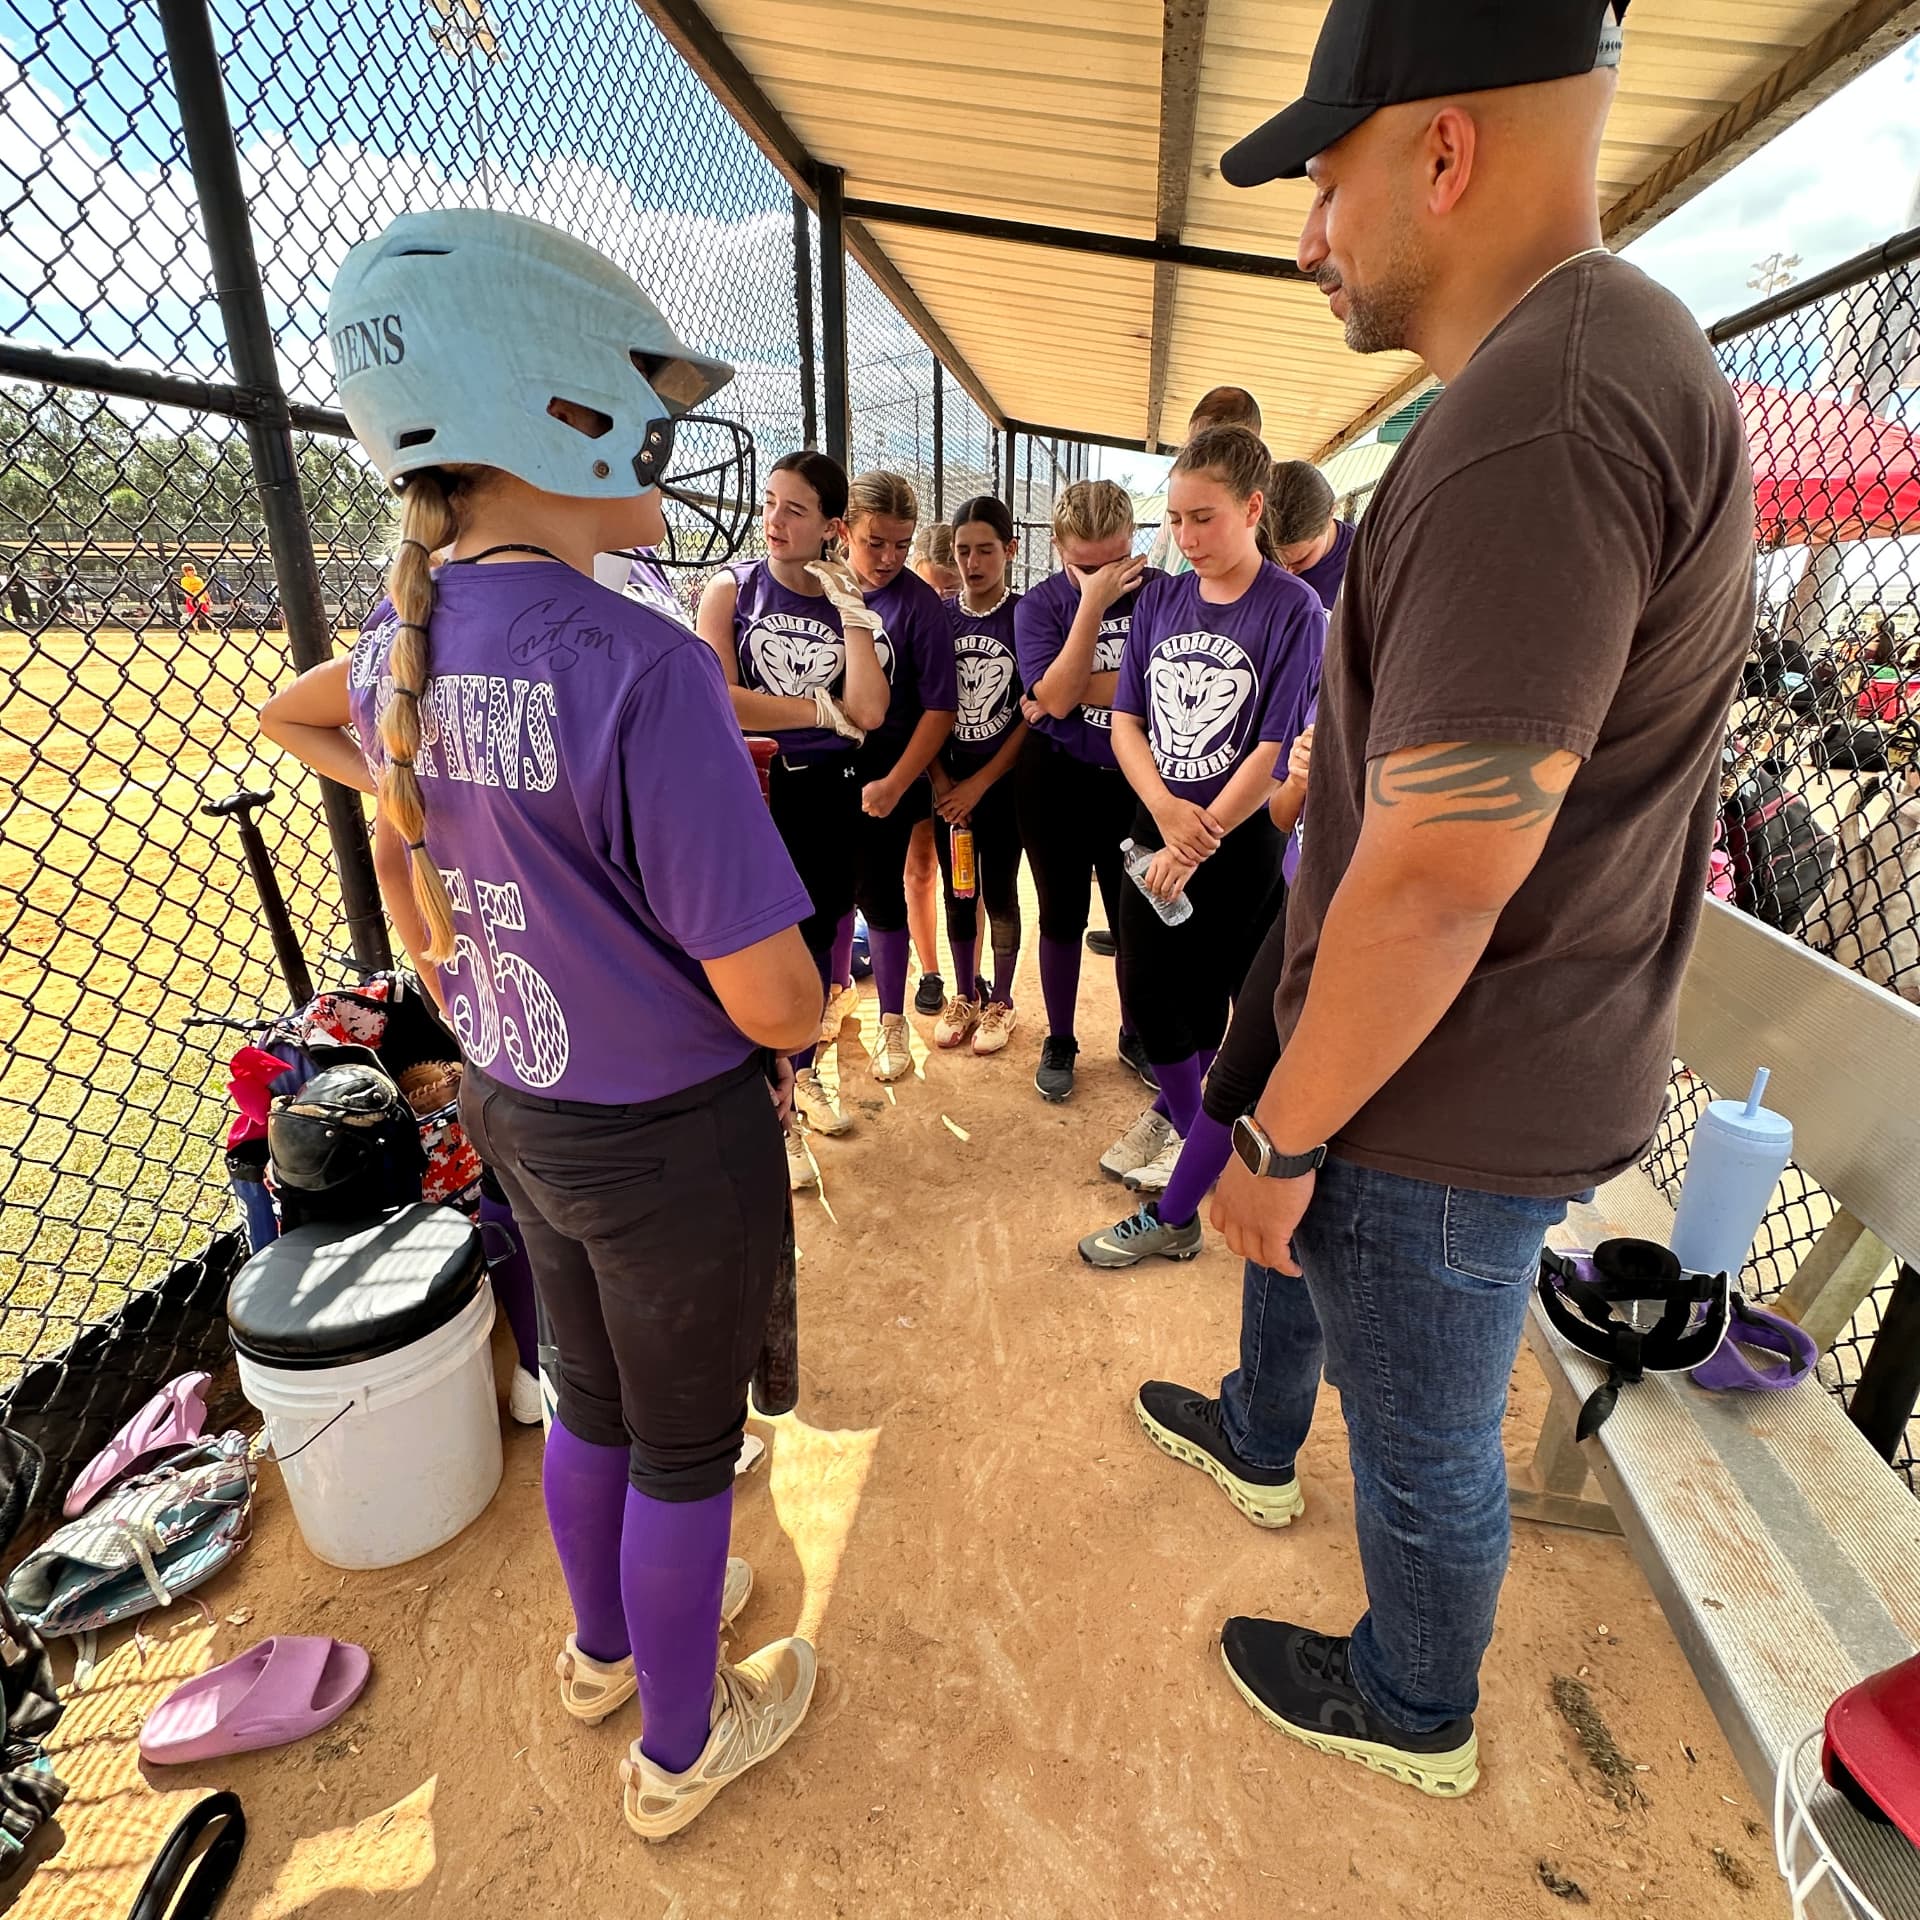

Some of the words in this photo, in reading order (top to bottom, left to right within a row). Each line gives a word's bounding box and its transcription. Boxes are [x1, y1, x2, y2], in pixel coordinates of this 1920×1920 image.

[328, 314, 405, 380] HENS
[954, 637, 977, 652] OBO
[978, 638, 1003, 658] GYM
[1161, 634, 1212, 660] GLOBO
[1209, 638, 1244, 668] GYM
[952, 724, 971, 739] PLE
[1174, 743, 1236, 779] COBRAS
